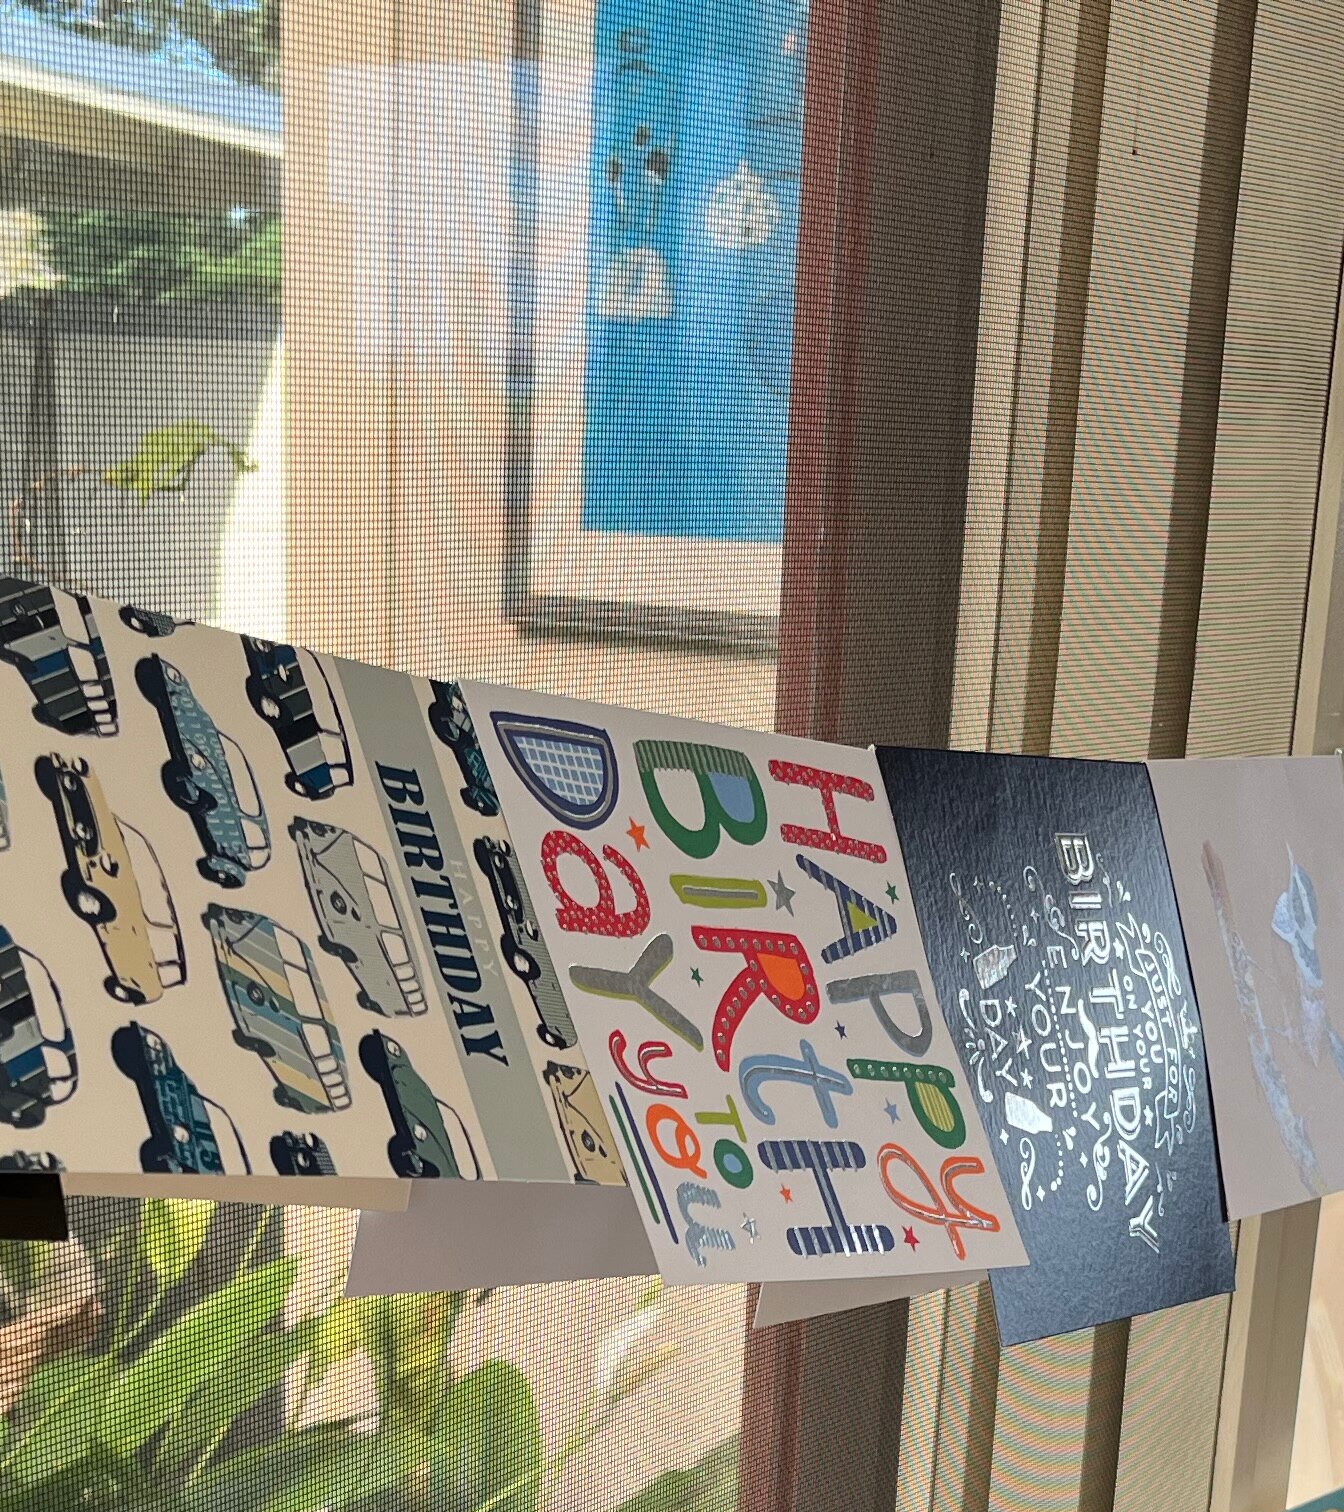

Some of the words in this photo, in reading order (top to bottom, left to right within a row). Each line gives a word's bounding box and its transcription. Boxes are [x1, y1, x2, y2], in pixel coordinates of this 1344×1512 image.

[374, 760, 510, 1067] BIRTHDAY
[448, 860, 500, 977] HAPPY
[979, 999, 1018, 1087] DAY
[1024, 972, 1068, 1108] YOUR
[1046, 945, 1101, 1131] ENJOY
[1055, 832, 1160, 1254] BIRTHDAY
[1123, 975, 1138, 1010] ON
[1133, 1023, 1153, 1090] YOUR
[1141, 1002, 1164, 1065] YOU
[1144, 961, 1172, 1028] JUST
[1167, 1048, 1179, 1105] FOR
